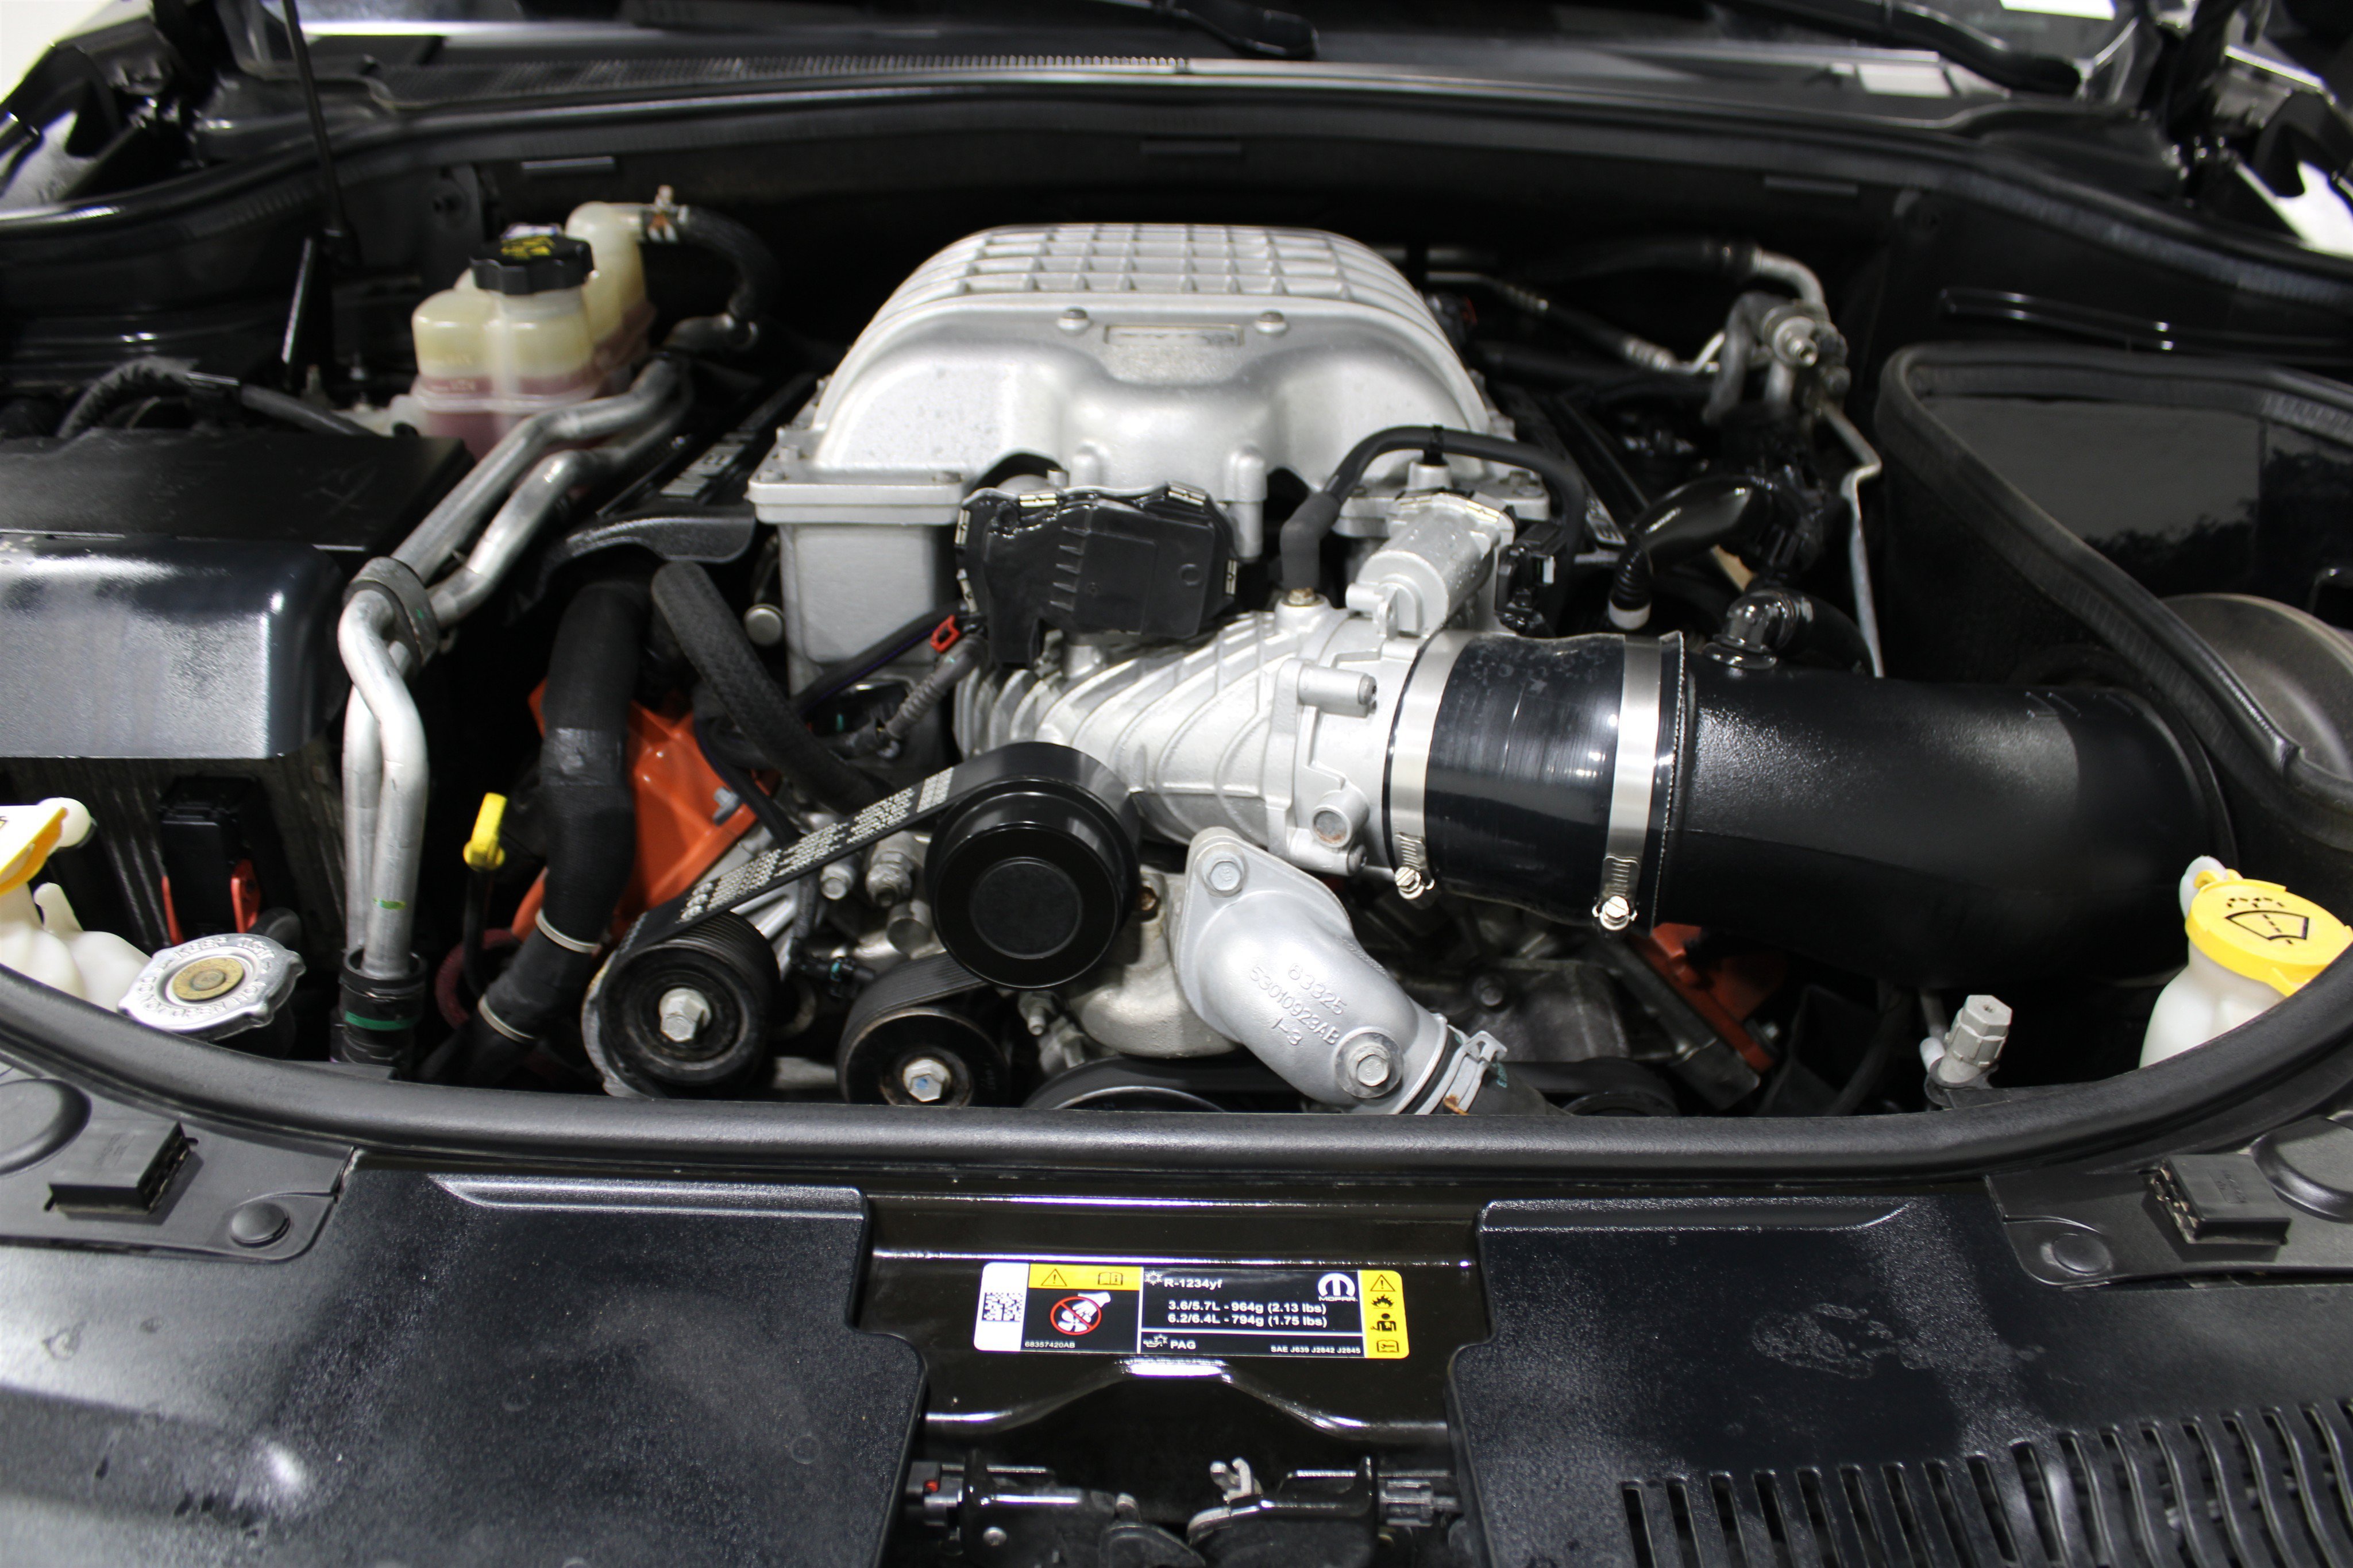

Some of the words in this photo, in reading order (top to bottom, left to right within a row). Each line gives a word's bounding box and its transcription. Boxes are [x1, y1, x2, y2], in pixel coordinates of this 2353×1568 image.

[1288, 963, 1348, 1015] 63325
[1164, 1279, 1223, 1289] R-1234yf
[1168, 1301, 1221, 1311] 3.6/5.7L
[1231, 1302, 1264, 1314] 964g
[1268, 1303, 1299, 1314] (2.13
[1302, 1304, 1327, 1315] lbs)
[1168, 1314, 1221, 1324] 6.2/6.4L
[1232, 1315, 1264, 1327] 794g
[1268, 1315, 1299, 1327] (1.75
[1302, 1316, 1328, 1328] lbs)
[1024, 1341, 1076, 1349] 68357420AB
[1170, 1341, 1197, 1350] PAG
